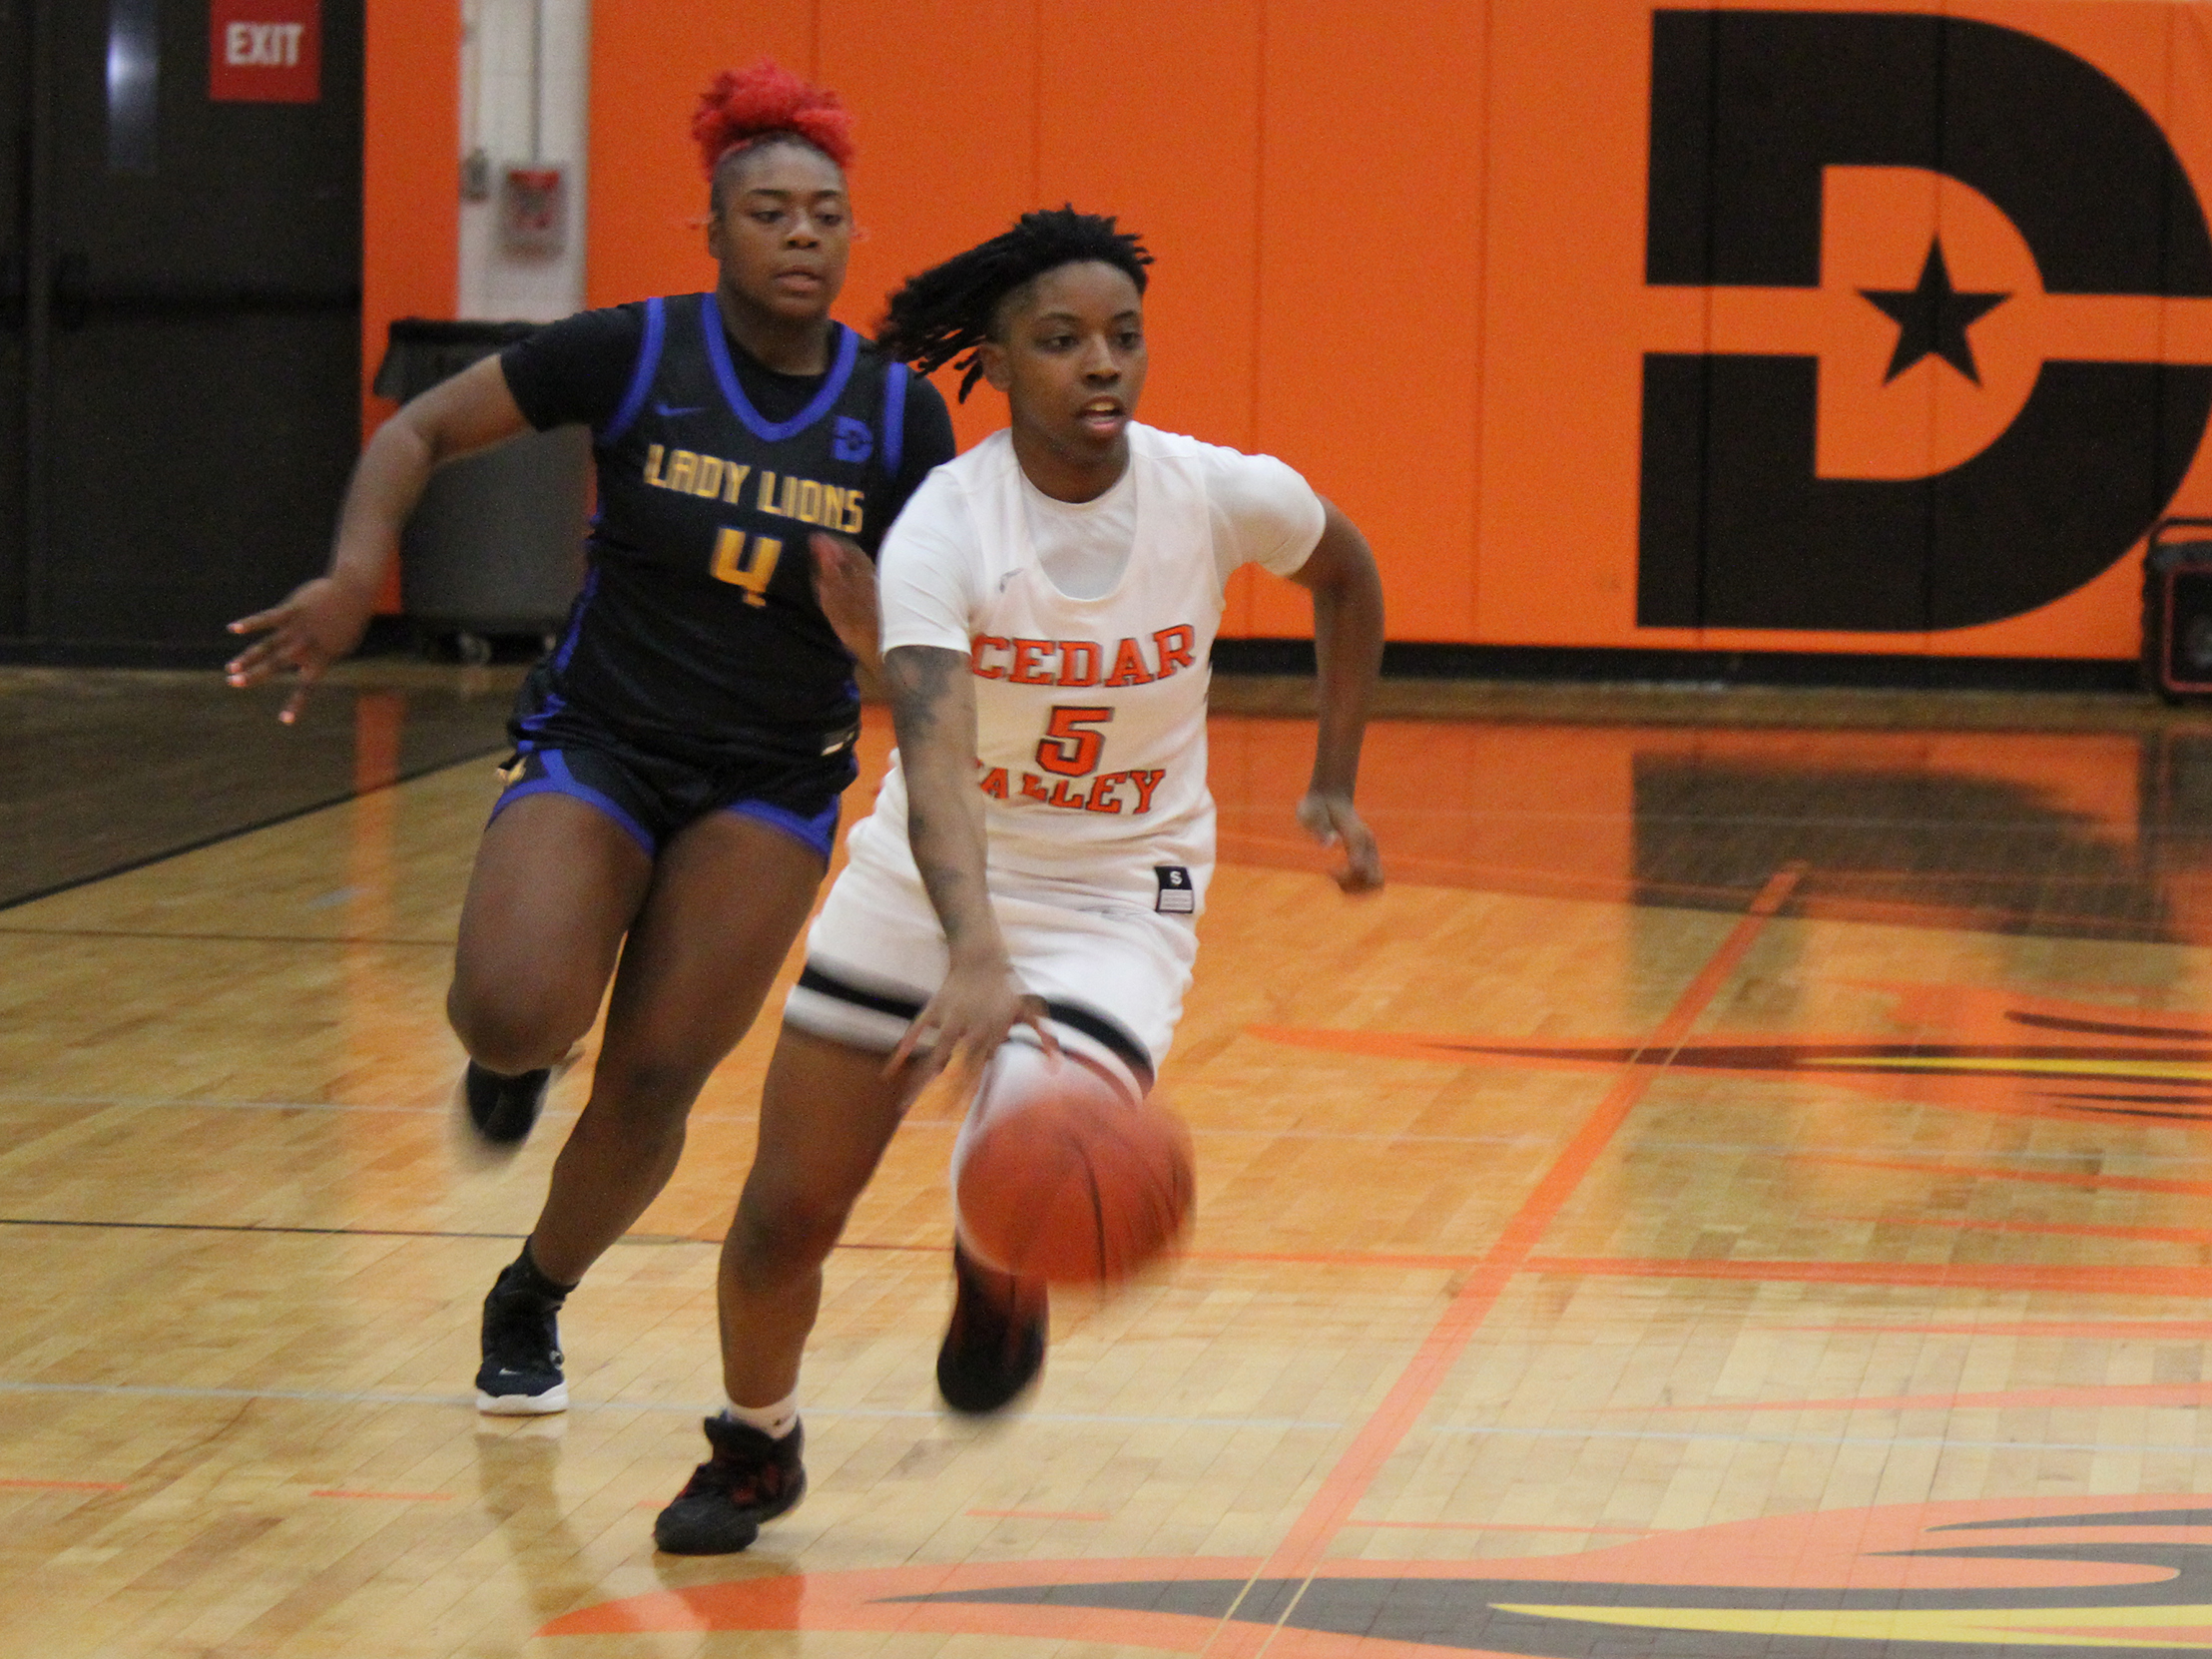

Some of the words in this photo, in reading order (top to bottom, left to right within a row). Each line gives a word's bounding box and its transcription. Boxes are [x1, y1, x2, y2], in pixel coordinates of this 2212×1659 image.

[227, 22, 303, 66] EXIT
[1635, 9, 2212, 633] D
[644, 443, 751, 504] LADY
[757, 470, 864, 534] LIONS
[709, 525, 783, 608] 4
[970, 623, 1197, 688] CEDAR
[1035, 705, 1115, 778] 5
[975, 758, 1166, 815] ALLEY
[1169, 870, 1183, 885] S
